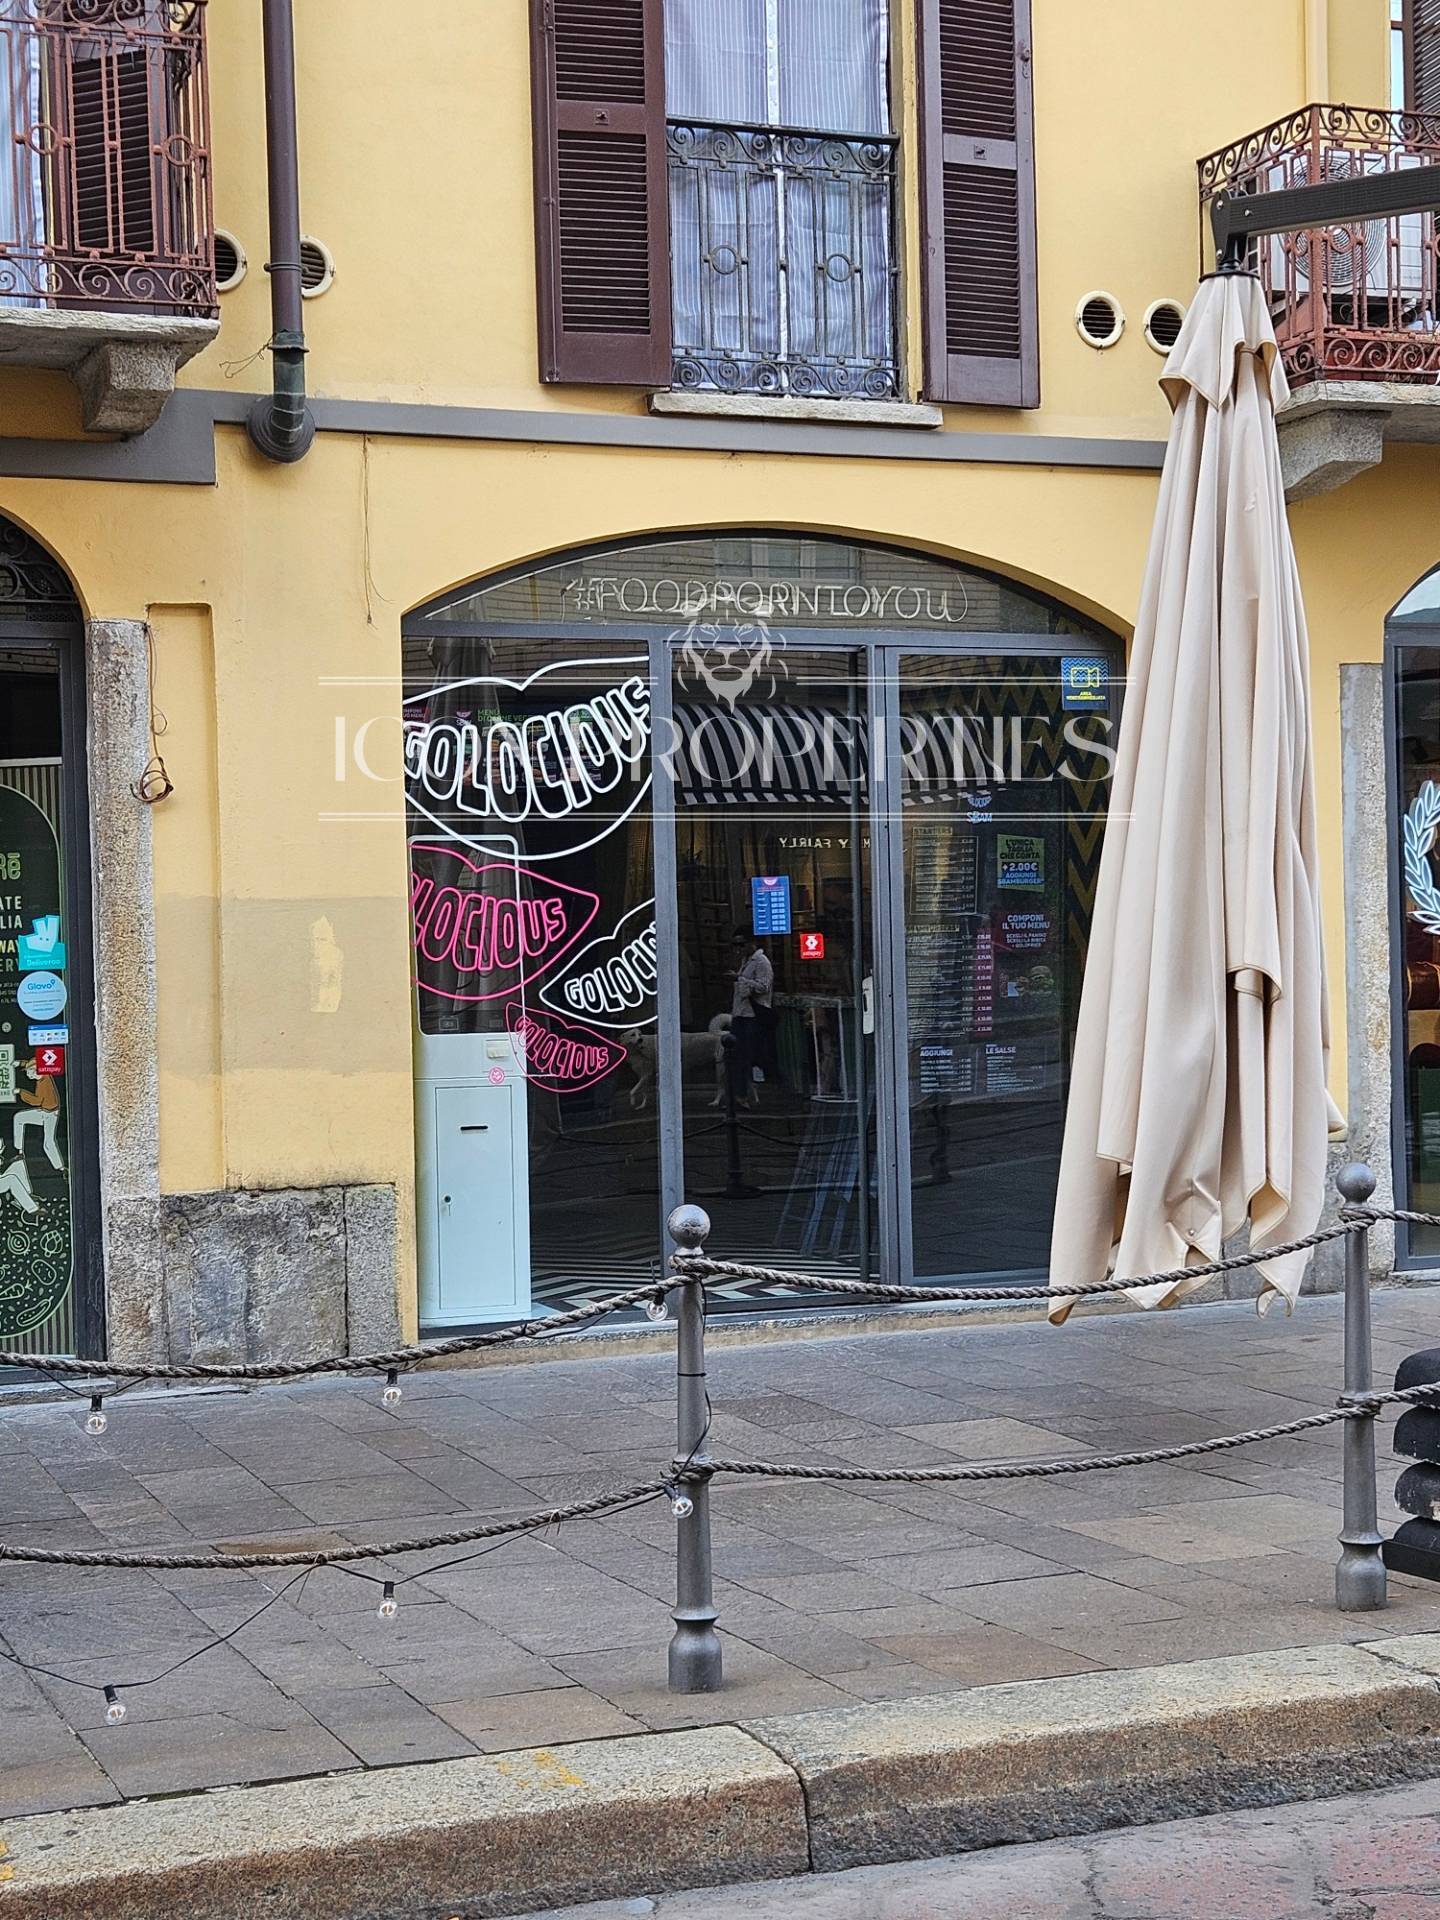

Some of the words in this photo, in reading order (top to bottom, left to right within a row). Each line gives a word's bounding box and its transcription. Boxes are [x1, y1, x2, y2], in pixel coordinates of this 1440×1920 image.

[26, 958, 61, 967] Deliveroo
[27, 981, 53, 991] Glovo
[514, 1016, 608, 1079] GOLOCIOUS
